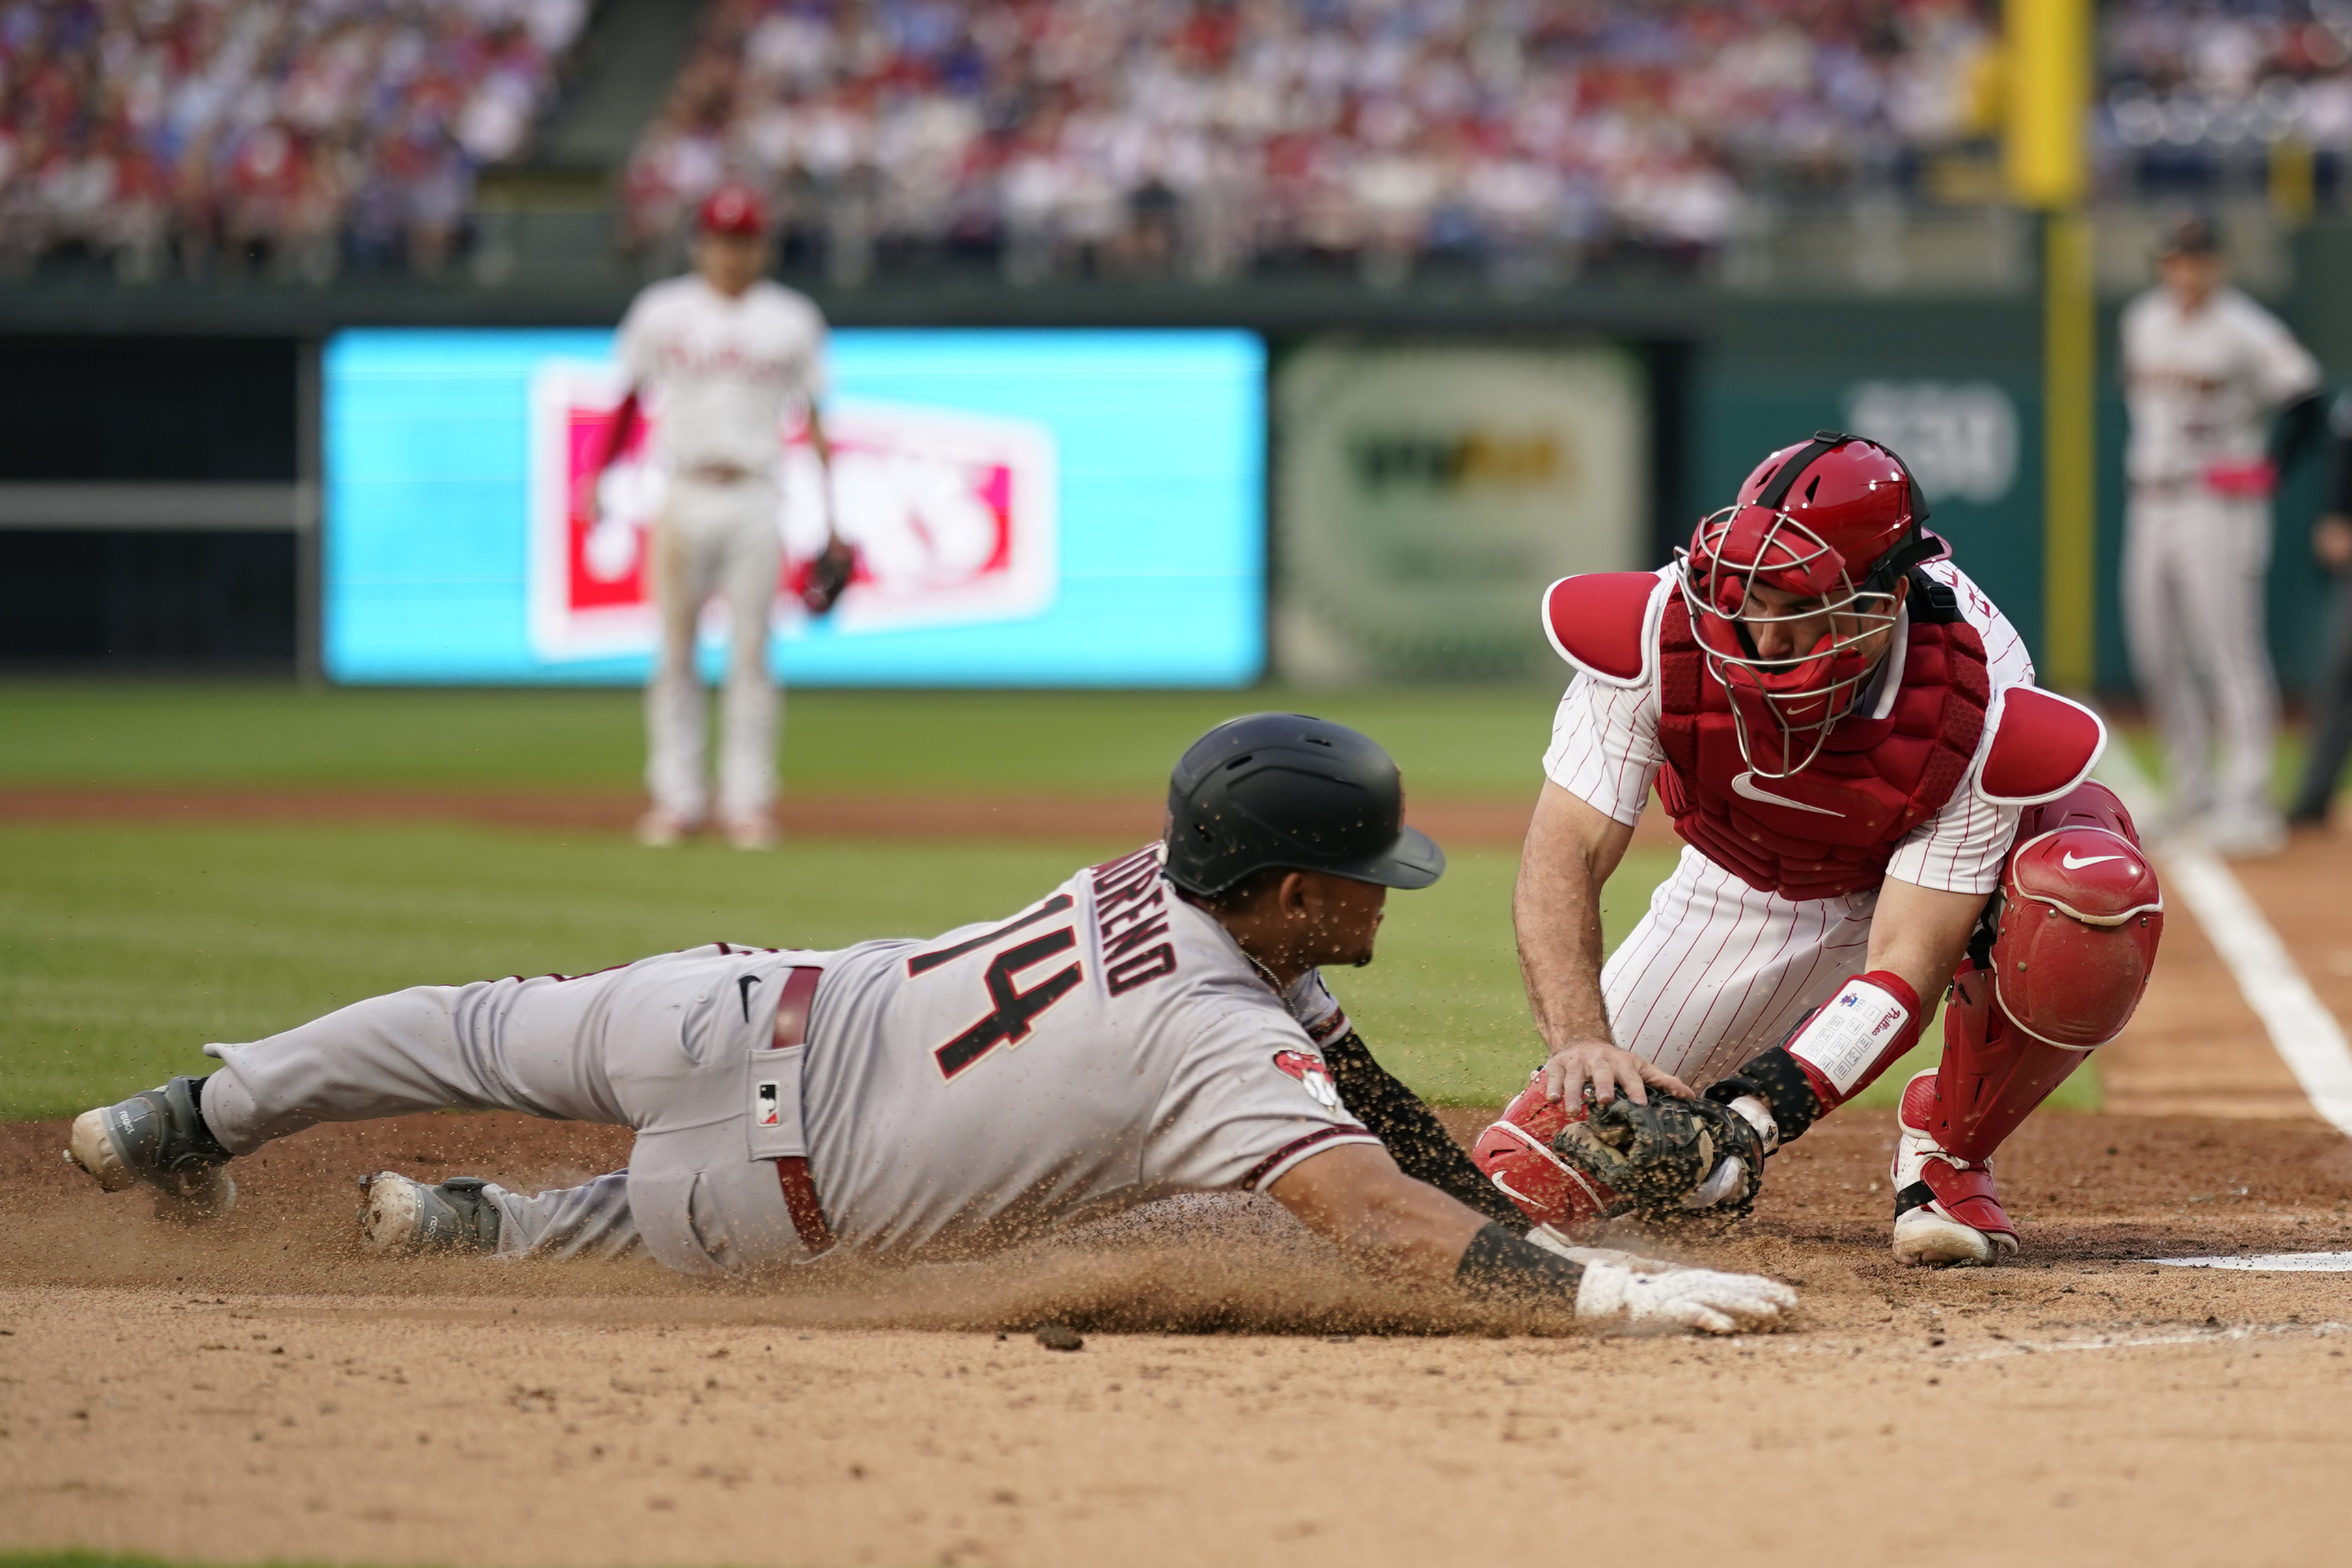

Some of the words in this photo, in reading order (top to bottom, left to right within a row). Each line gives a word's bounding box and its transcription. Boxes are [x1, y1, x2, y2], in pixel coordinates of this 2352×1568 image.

[906, 892, 1085, 1083] 14
[1090, 840, 1177, 998] ORENO
[1872, 1007, 1900, 1036] Phillies
